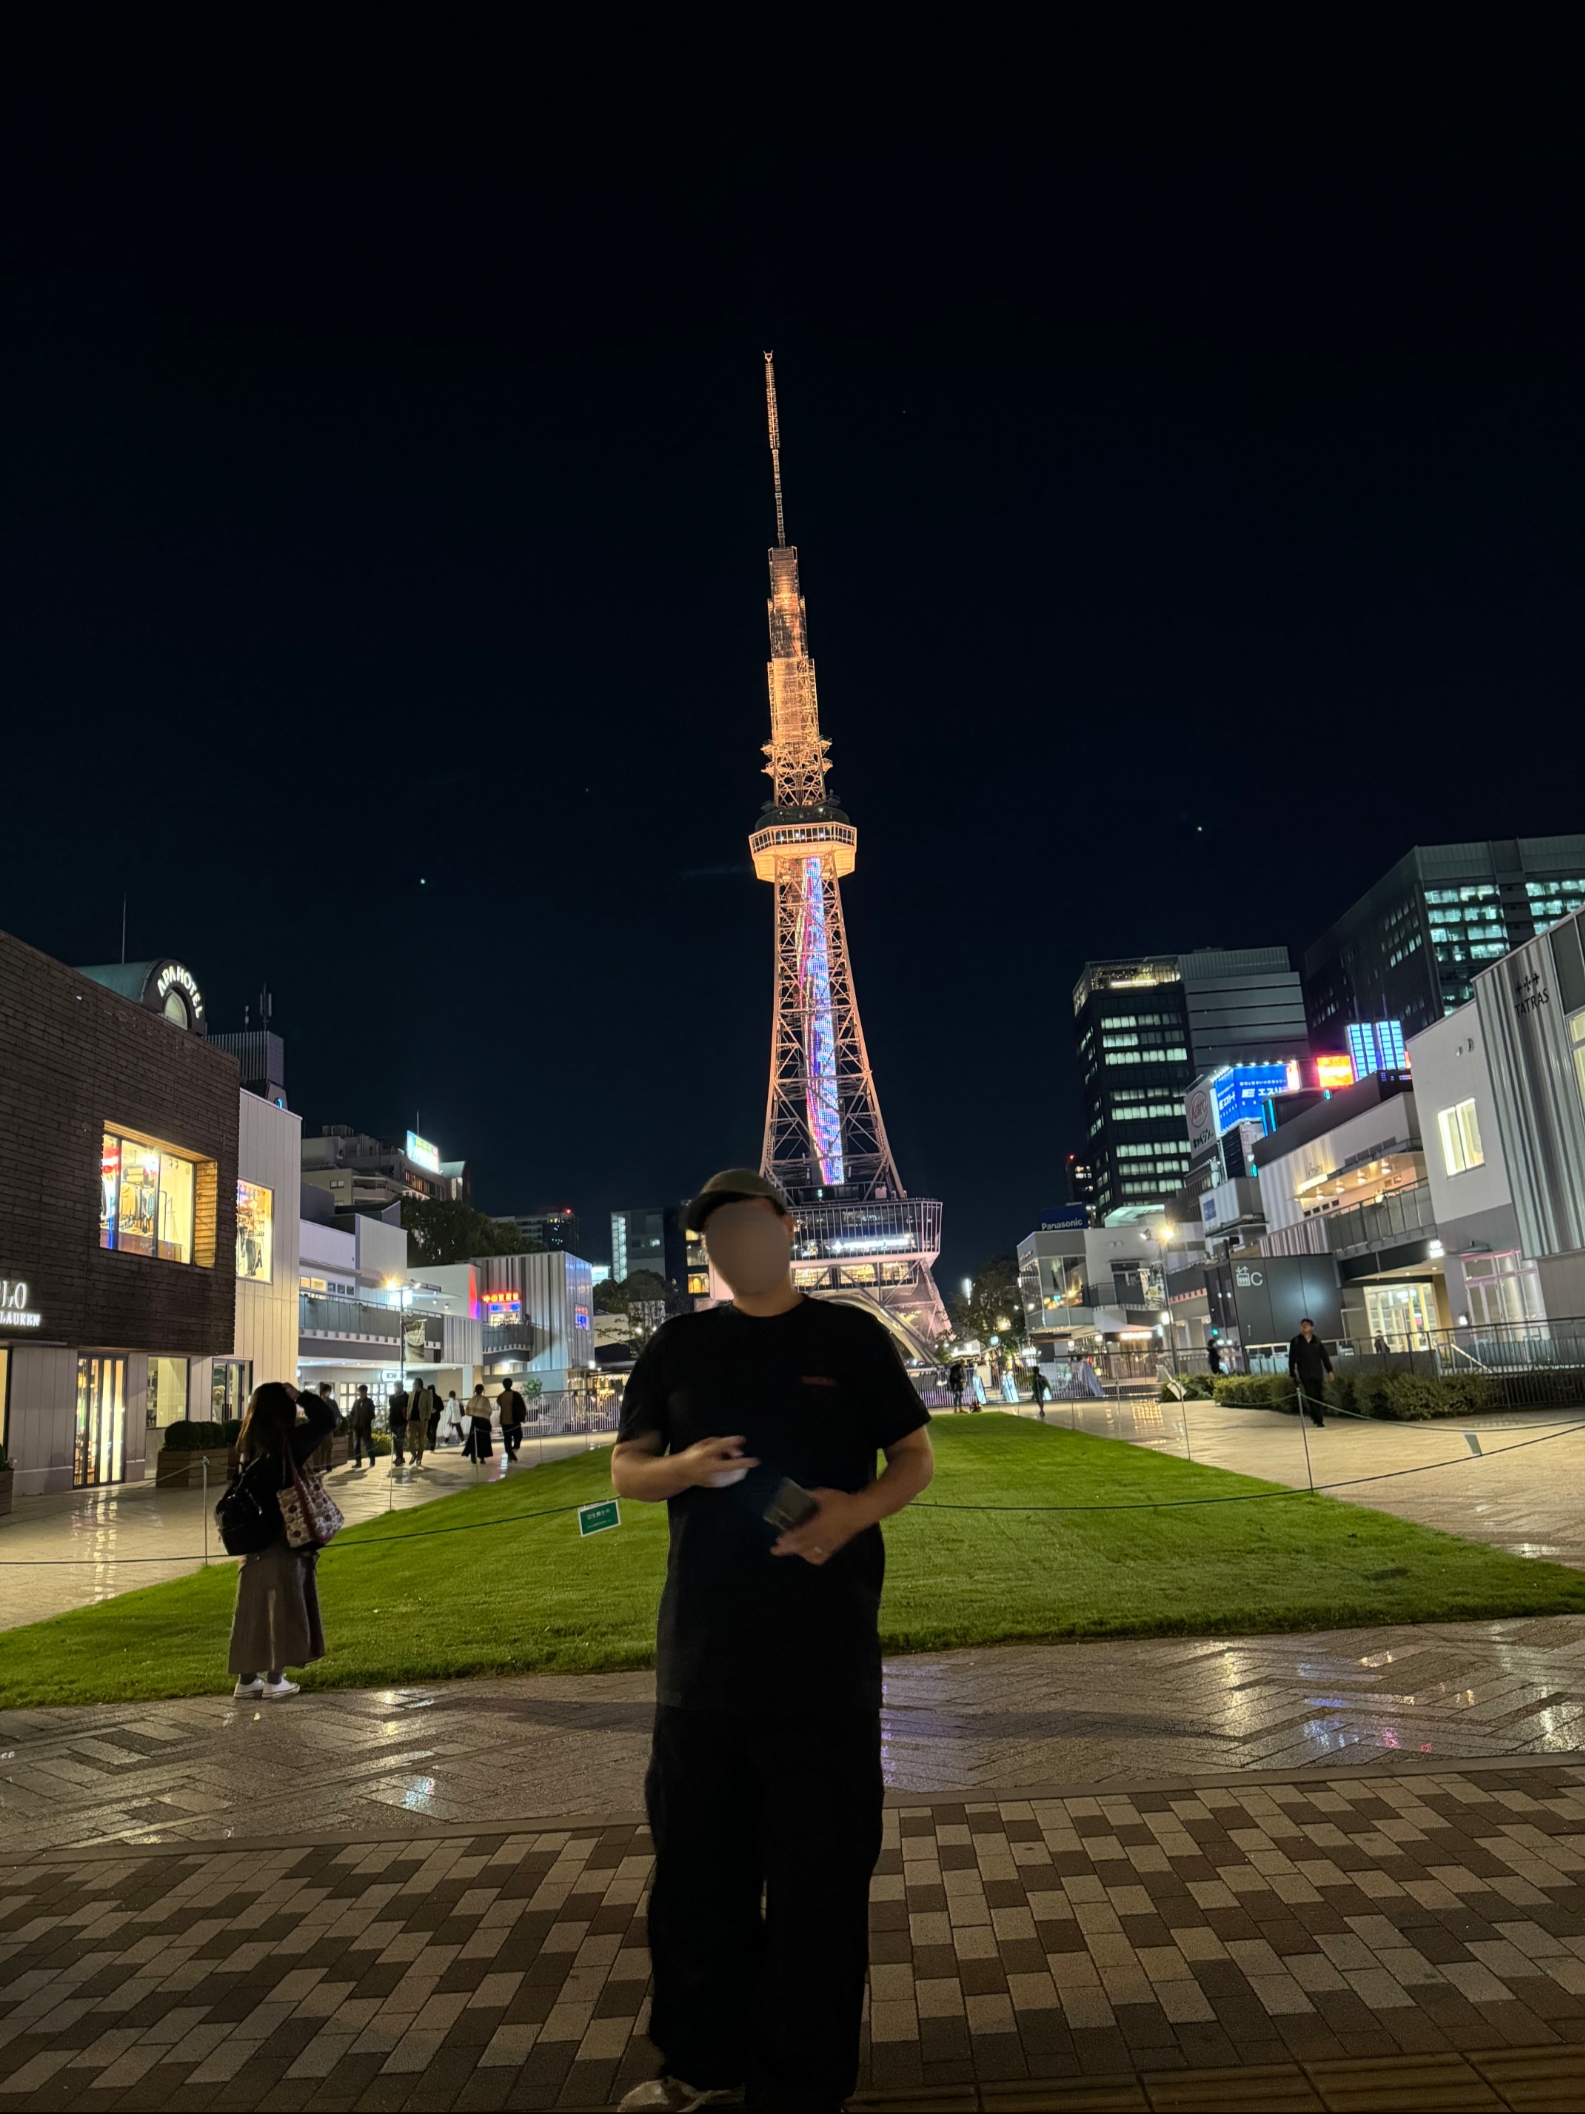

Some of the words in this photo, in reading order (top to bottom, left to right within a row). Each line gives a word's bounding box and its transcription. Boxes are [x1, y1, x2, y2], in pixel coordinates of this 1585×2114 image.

[157, 965, 177, 997] APA
[176, 965, 203, 1019] HOTEL
[1514, 987, 1549, 1018] TATRAS
[1041, 1217, 1083, 1231] Panasonic
[1250, 1271, 1264, 1287] C
[0, 1280, 28, 1310] LO
